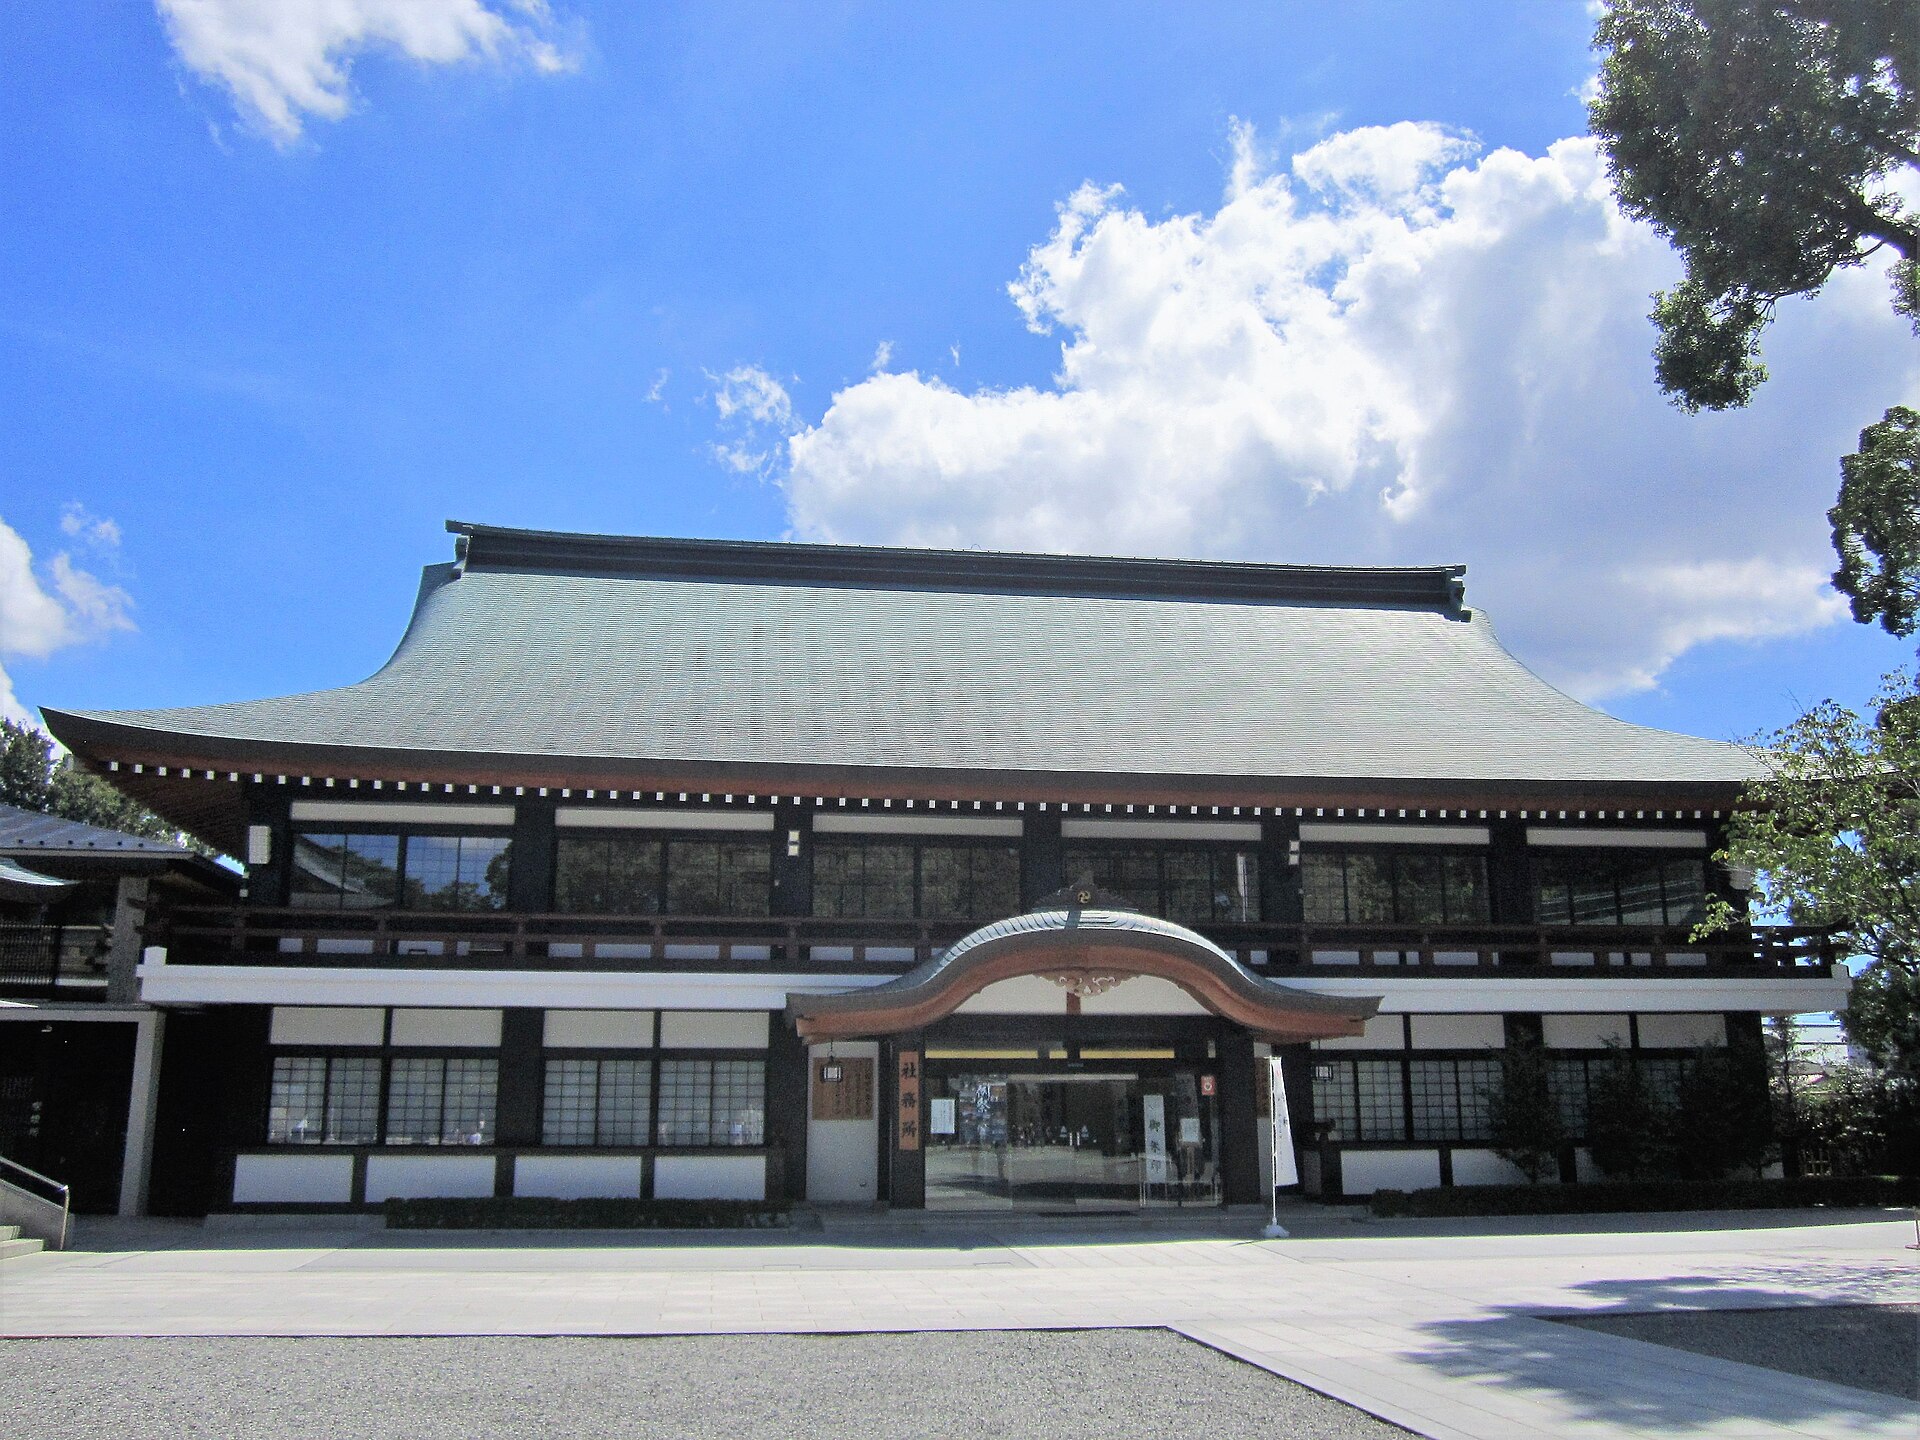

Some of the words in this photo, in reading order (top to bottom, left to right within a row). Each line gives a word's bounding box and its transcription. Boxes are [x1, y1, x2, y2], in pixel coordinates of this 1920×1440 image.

[901, 1062, 917, 1138] 社務所
[1148, 1119, 1161, 1174] 御朱印
